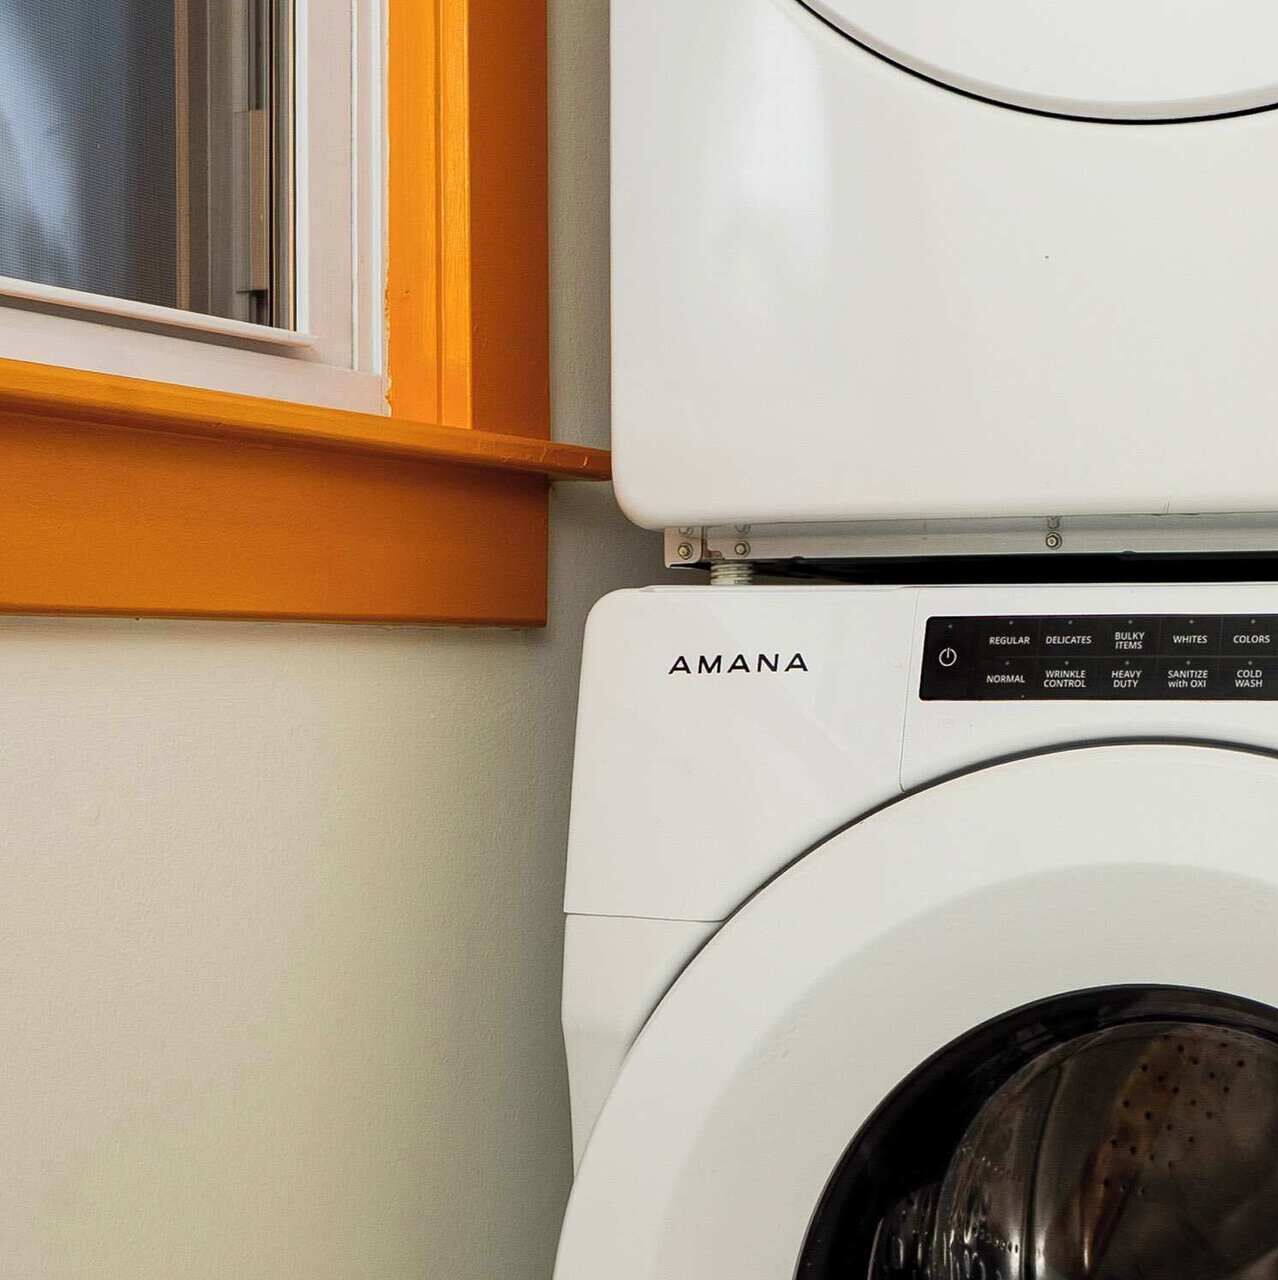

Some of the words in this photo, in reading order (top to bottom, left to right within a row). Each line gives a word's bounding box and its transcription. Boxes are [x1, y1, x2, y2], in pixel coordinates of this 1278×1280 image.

[989, 636, 1030, 645] REGULAR
[1046, 635, 1092, 644] DELICATES
[1115, 632, 1145, 641] BULKY
[1173, 635, 1208, 644] WHITES
[1233, 634, 1271, 644] COLORS
[1115, 641, 1143, 650] ITEMS
[668, 652, 809, 675] AMANA
[1045, 670, 1086, 679] WRINKLE
[1111, 670, 1142, 679] HEAVY
[1168, 670, 1209, 679] SANITIZE
[1236, 670, 1263, 679] COLD
[986, 675, 1025, 684] NORMAL
[1043, 679, 1087, 688] CONTROL
[1113, 679, 1138, 688] DUTY
[1168, 679, 1188, 688] with
[1191, 679, 1207, 688] OXI
[1235, 679, 1263, 688] WASH
